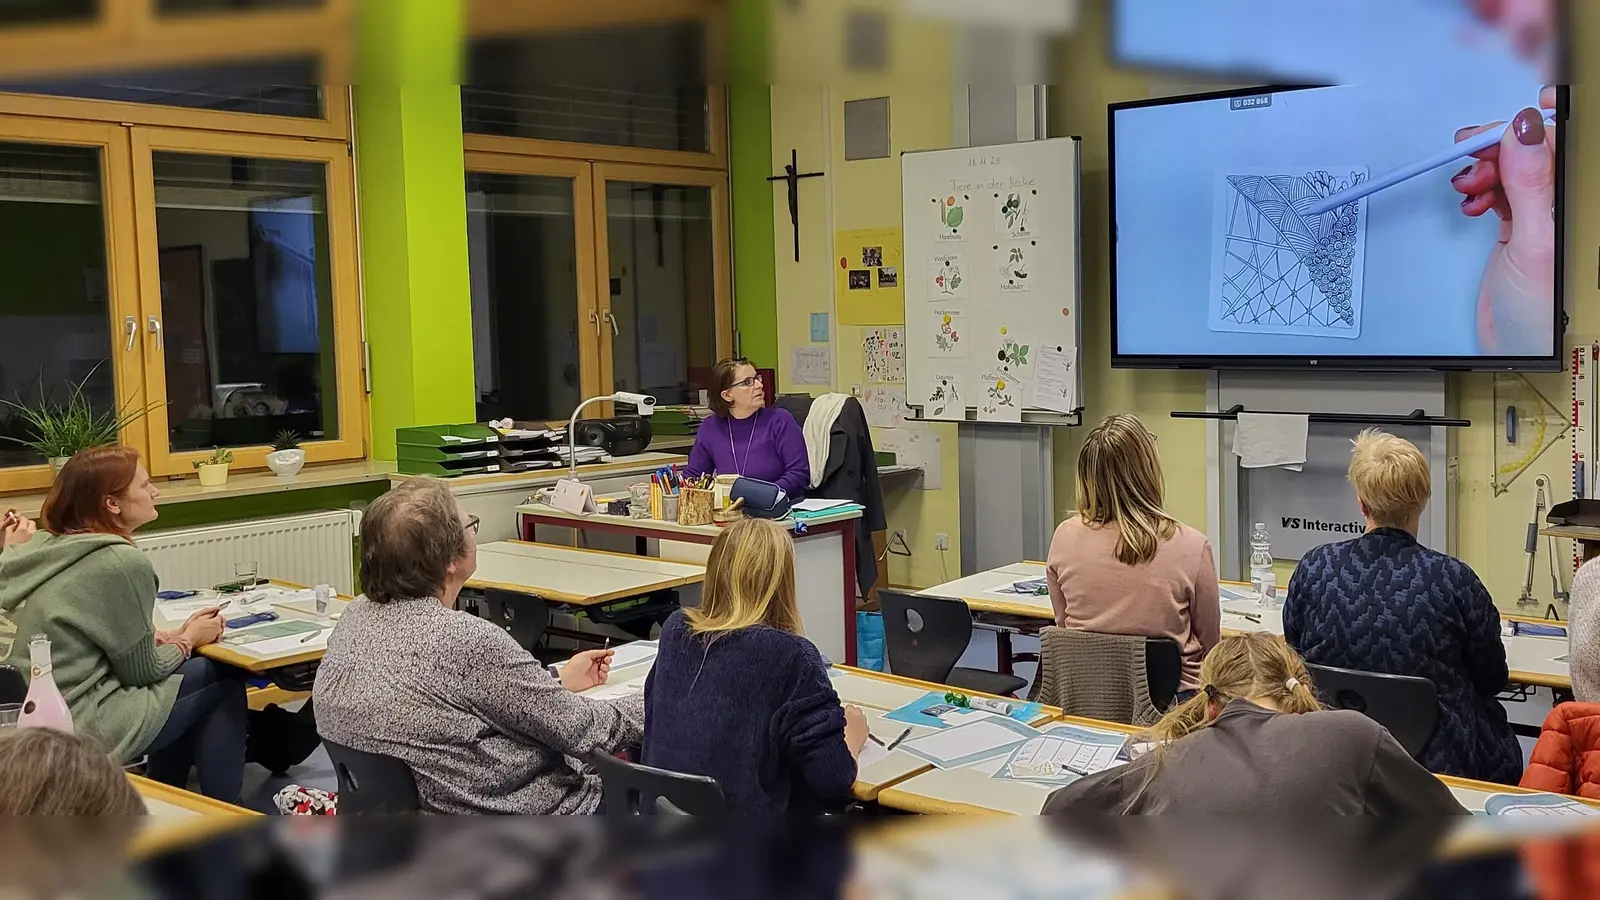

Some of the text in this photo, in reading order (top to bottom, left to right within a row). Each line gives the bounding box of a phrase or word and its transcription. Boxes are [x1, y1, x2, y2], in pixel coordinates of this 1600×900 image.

[949, 179, 973, 191] Tiere
[1281, 516, 1367, 534] VS Interactiv
